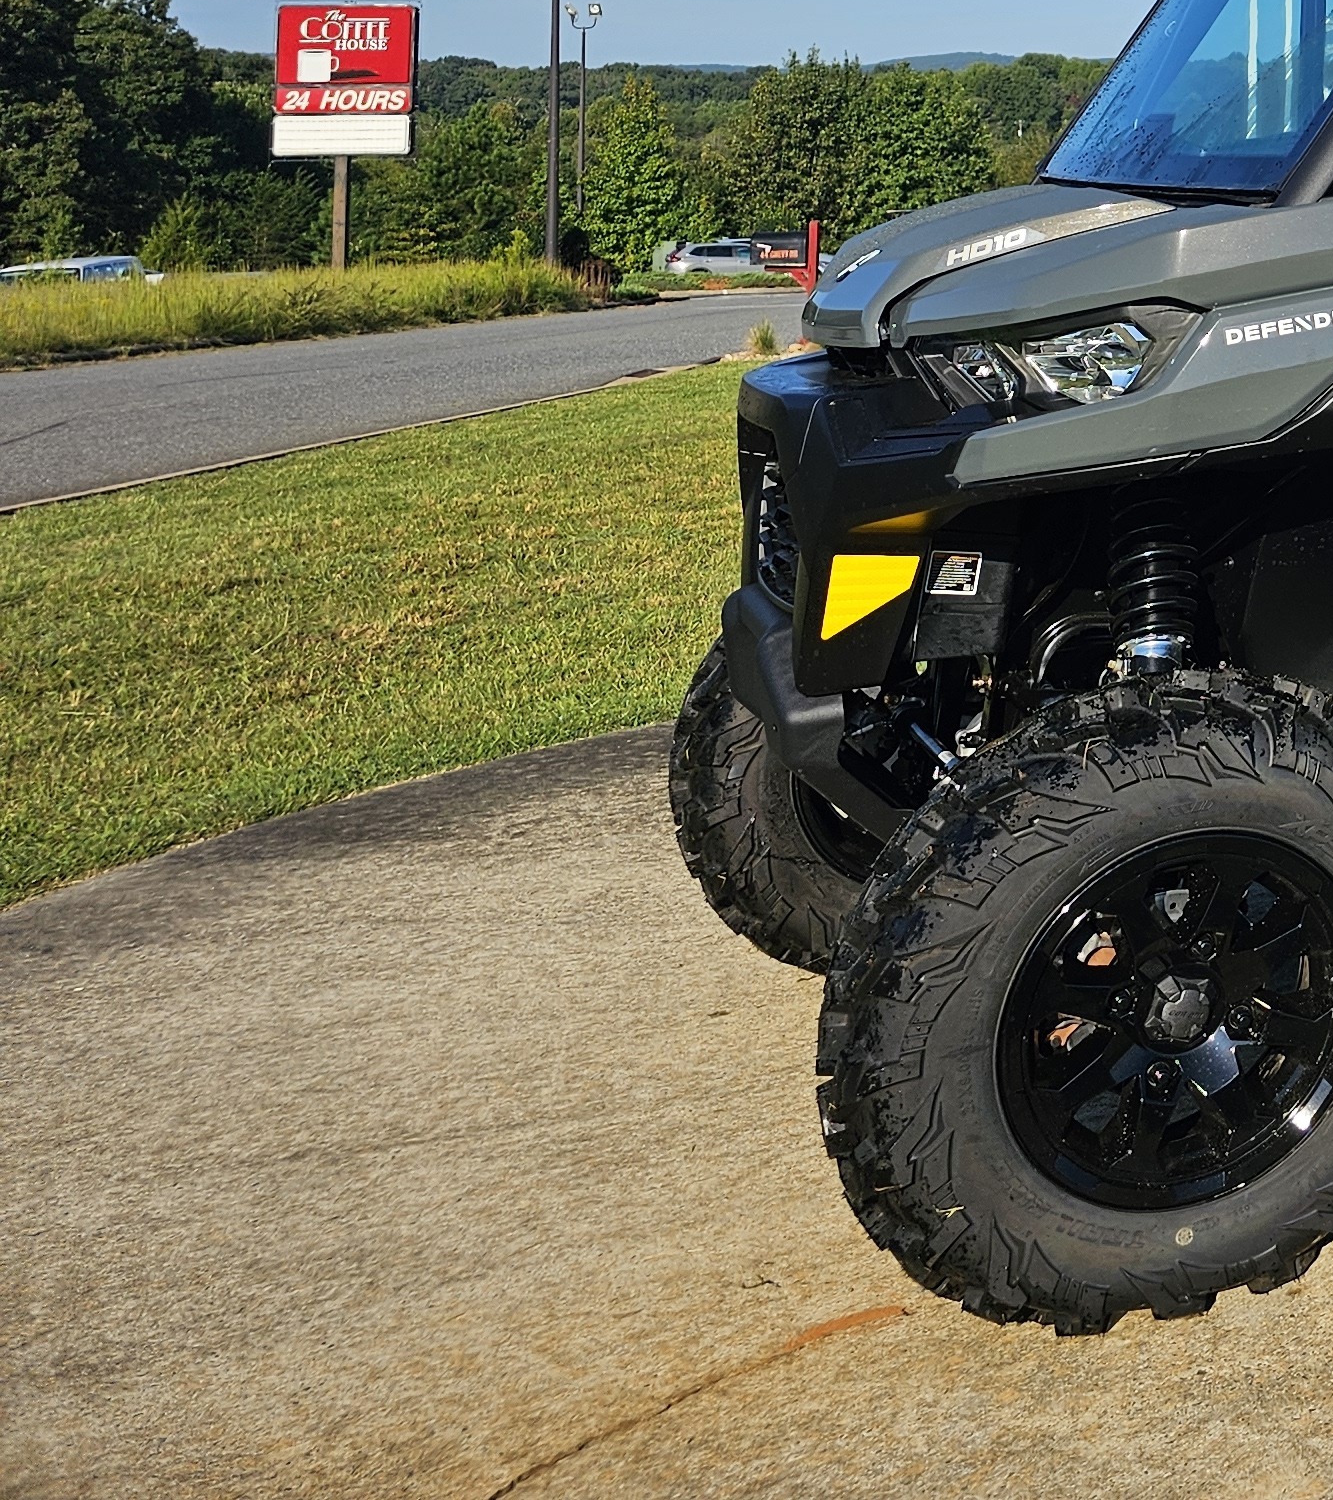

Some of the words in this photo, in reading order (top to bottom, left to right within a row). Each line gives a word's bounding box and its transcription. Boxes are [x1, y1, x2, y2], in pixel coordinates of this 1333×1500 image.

[324, 9, 347, 22] The
[299, 17, 390, 41] COFFEE
[334, 38, 388, 51] HOUSE
[282, 90, 310, 111] 24
[320, 90, 407, 111] HOURS
[946, 228, 1027, 267] HD10
